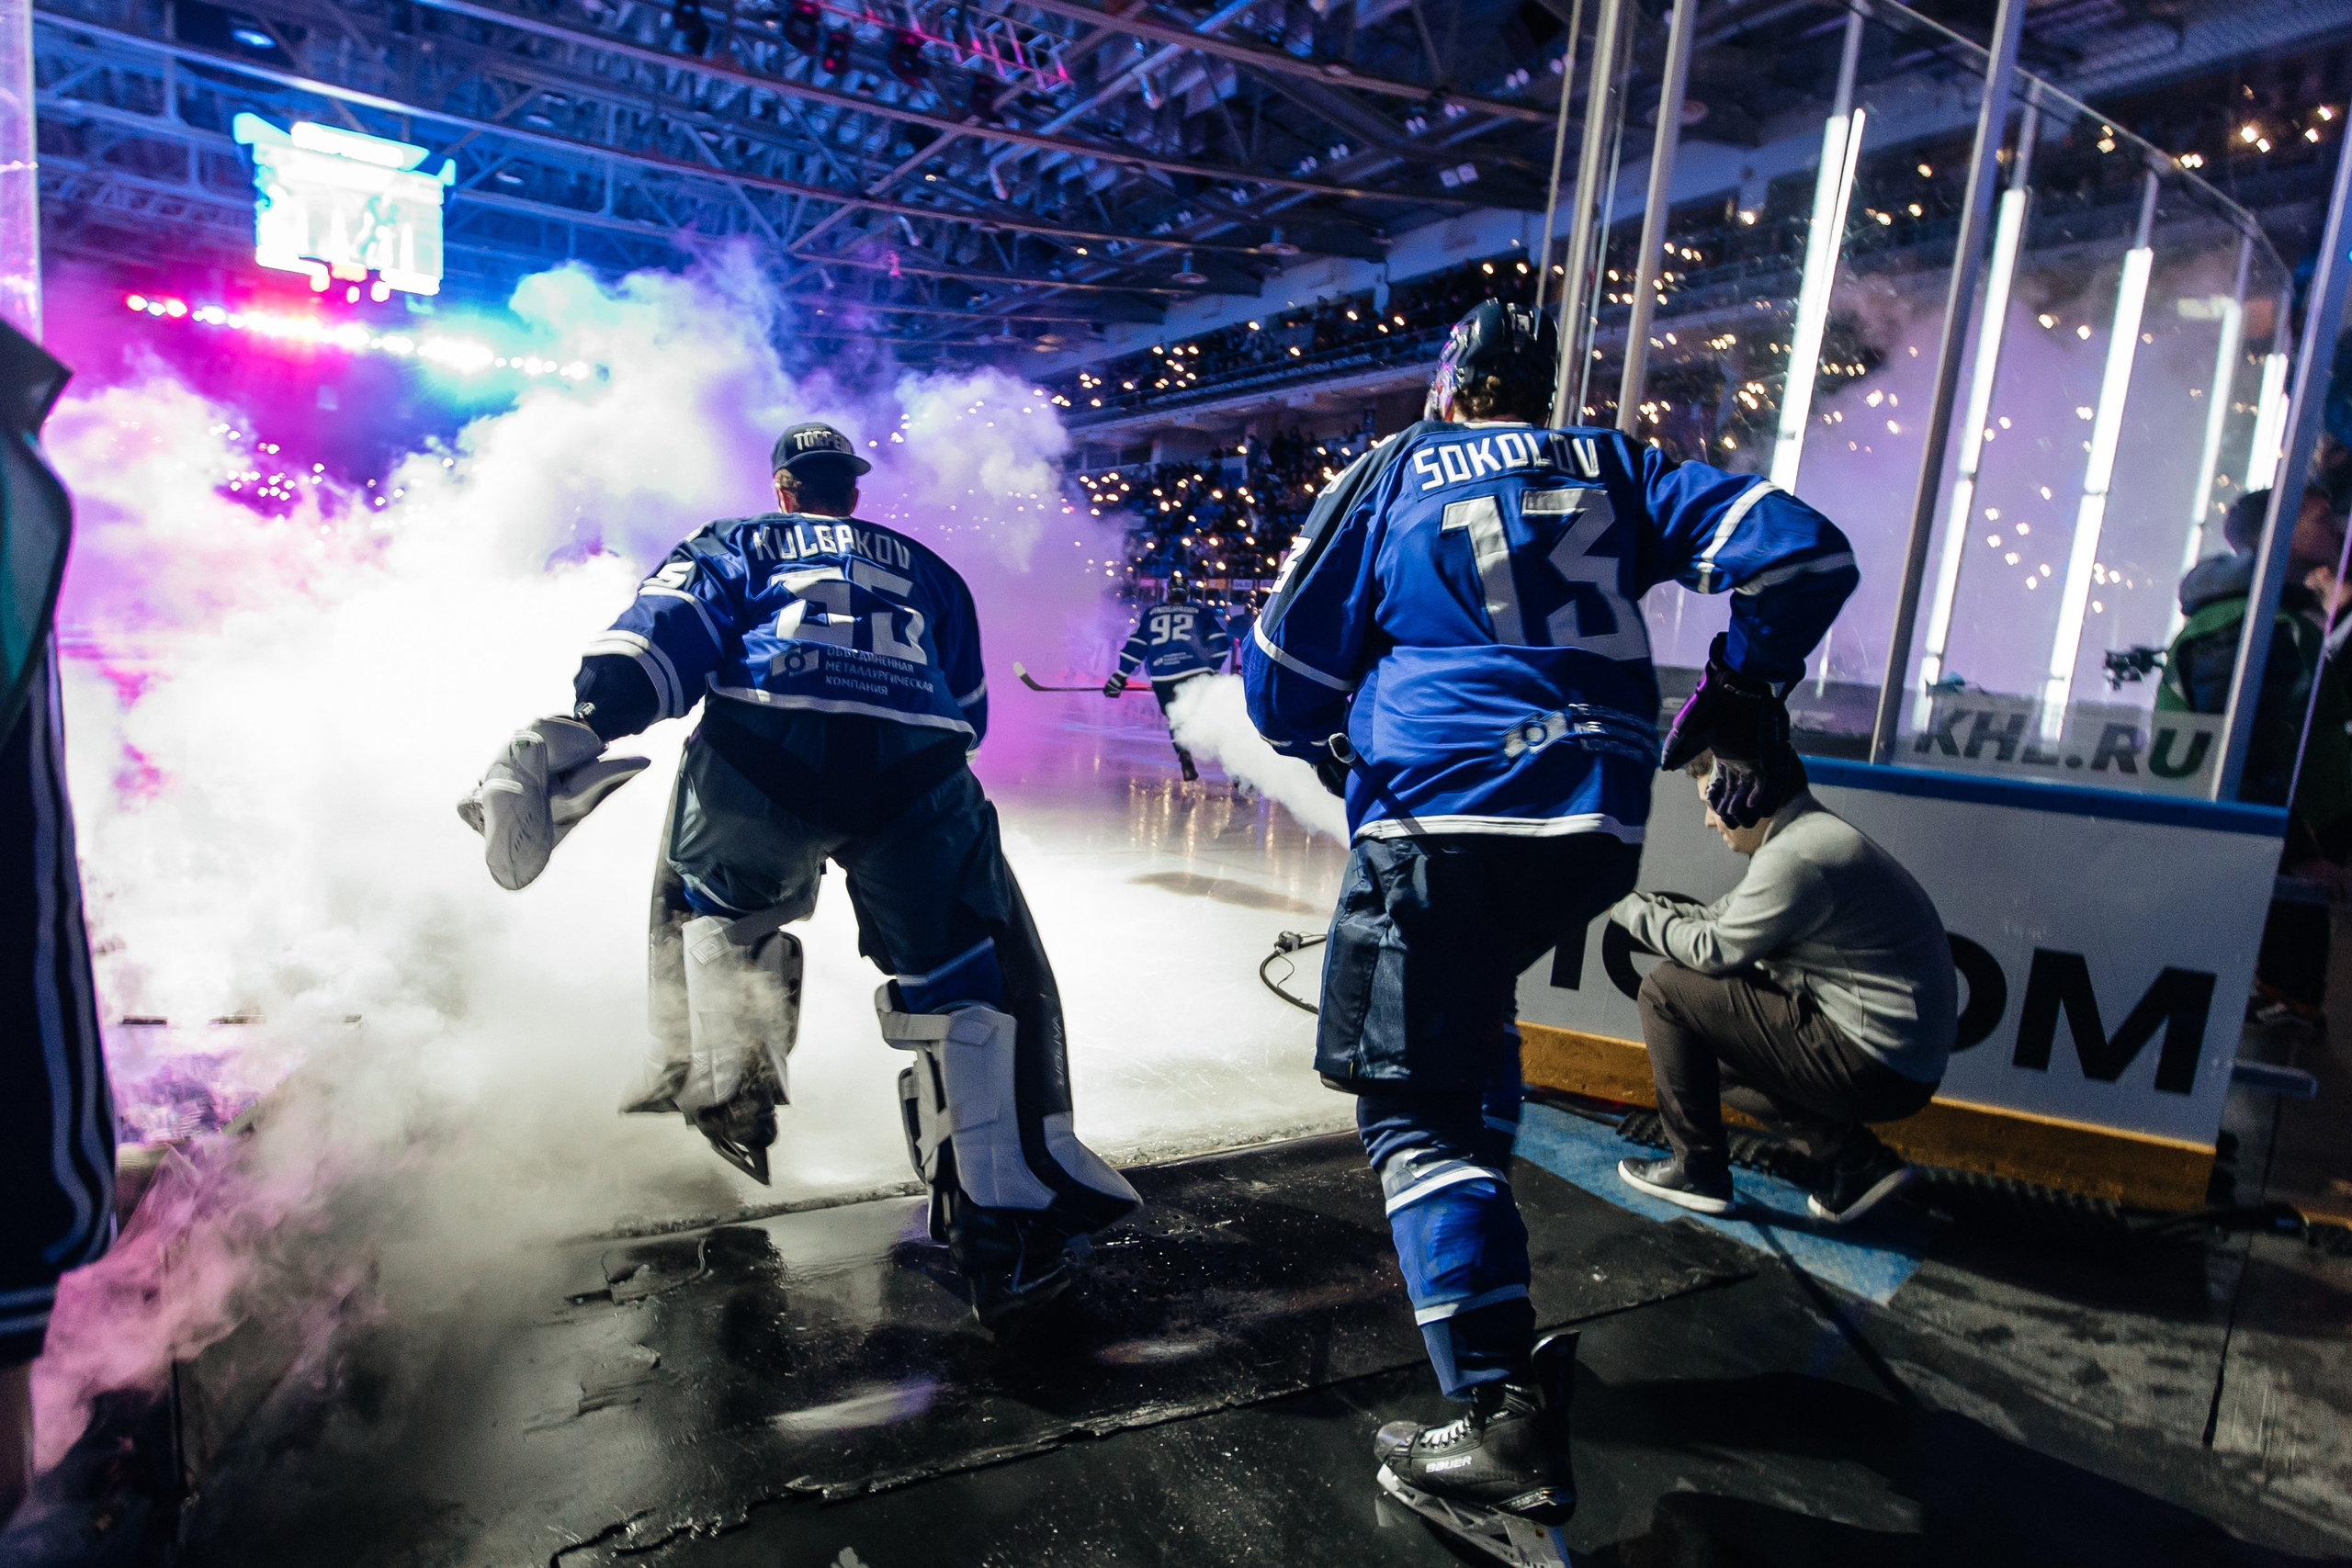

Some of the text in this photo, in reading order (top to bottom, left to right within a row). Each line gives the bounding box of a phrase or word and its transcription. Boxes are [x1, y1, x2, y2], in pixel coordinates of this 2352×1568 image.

[1414, 432, 1600, 491] SOKOLOV
[752, 525, 910, 570] KULBAKOV
[1442, 487, 1648, 660] 13
[1150, 614, 1194, 646] 92
[826, 660, 933, 694] МЕТАЛЛУРГИЧЕСКАЯ
[826, 675, 888, 695] КОМПАНИЯ
[1914, 709, 2213, 779] KHL.RU
[1426, 1456, 1472, 1473] BAUER
